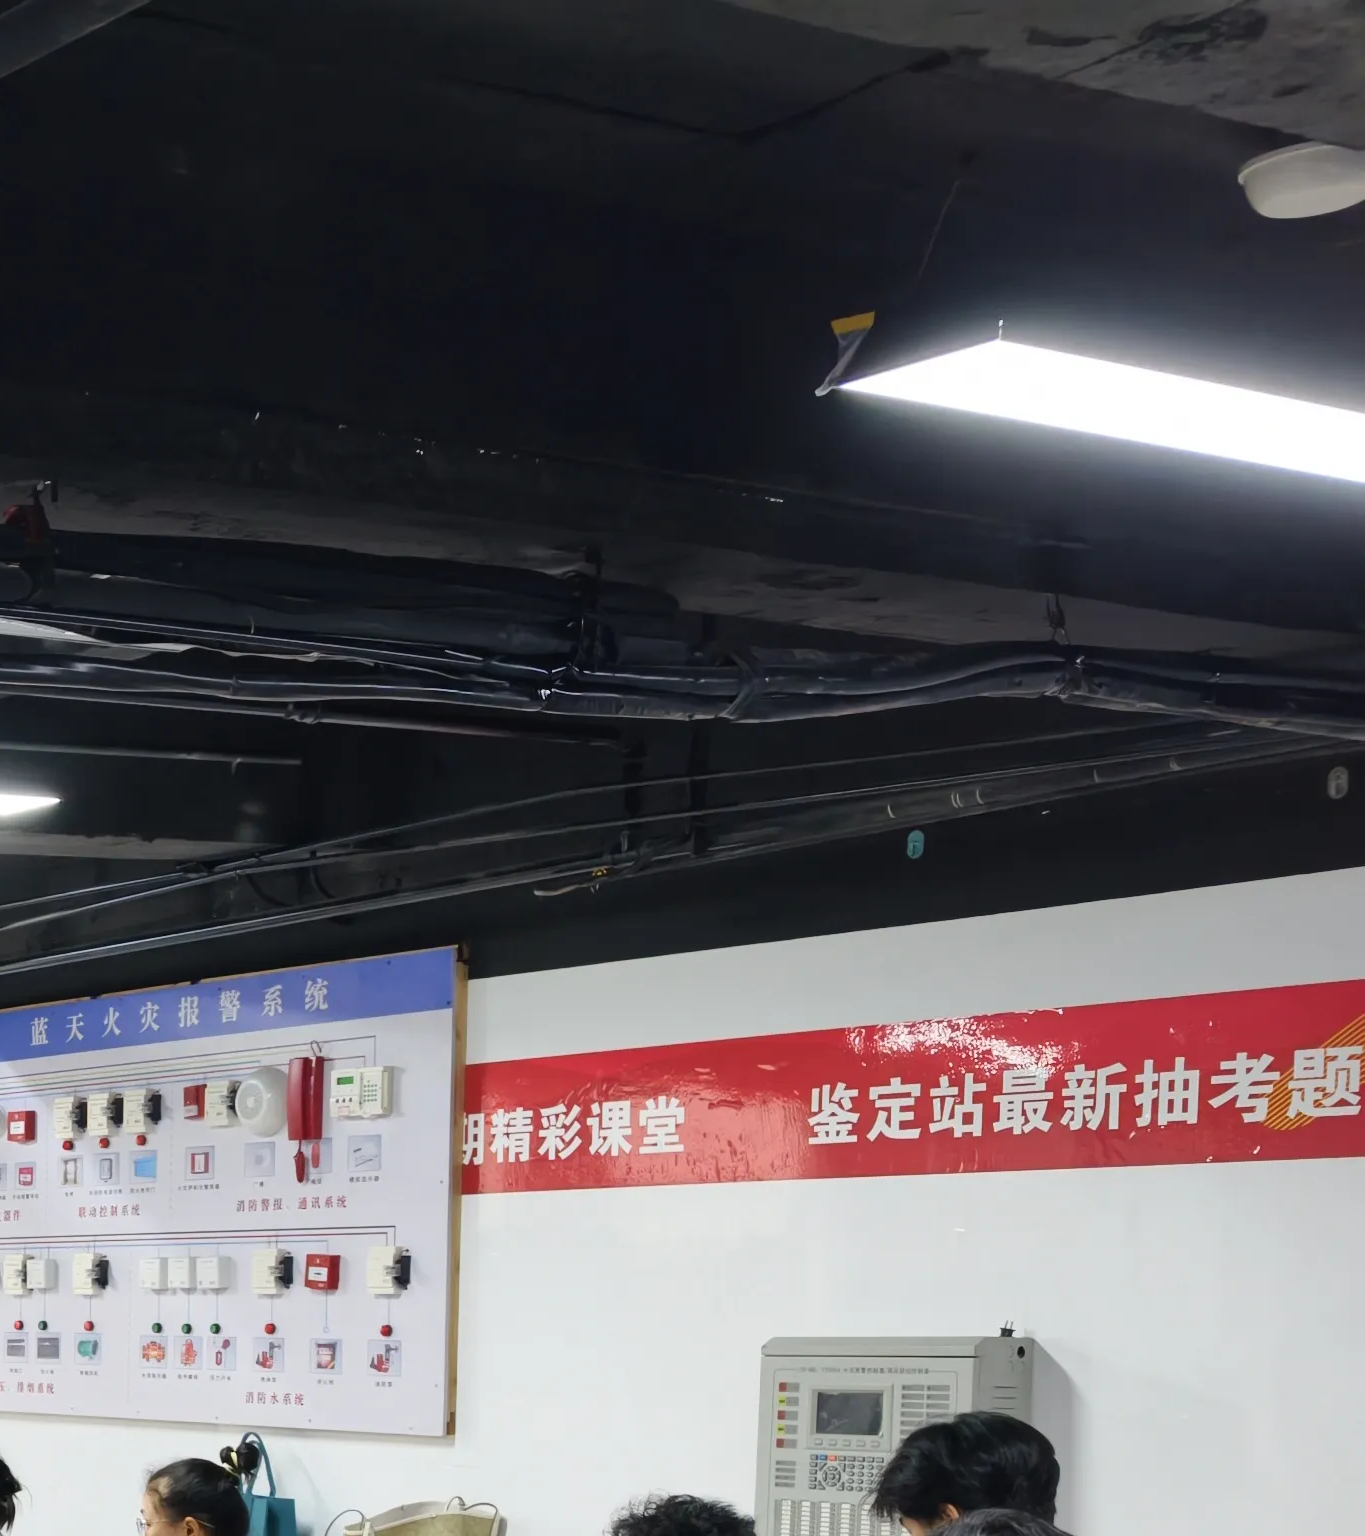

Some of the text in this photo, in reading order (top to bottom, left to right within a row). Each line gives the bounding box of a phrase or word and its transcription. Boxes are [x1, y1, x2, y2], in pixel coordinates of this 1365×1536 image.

[29, 979, 329, 1046] 蓝天火灾报警系统
[807, 1045, 1365, 1145] 鉴定站最新抽考题
[78, 1204, 141, 1218] 联动控制系统
[245, 1391, 305, 1407] 消防水系统
